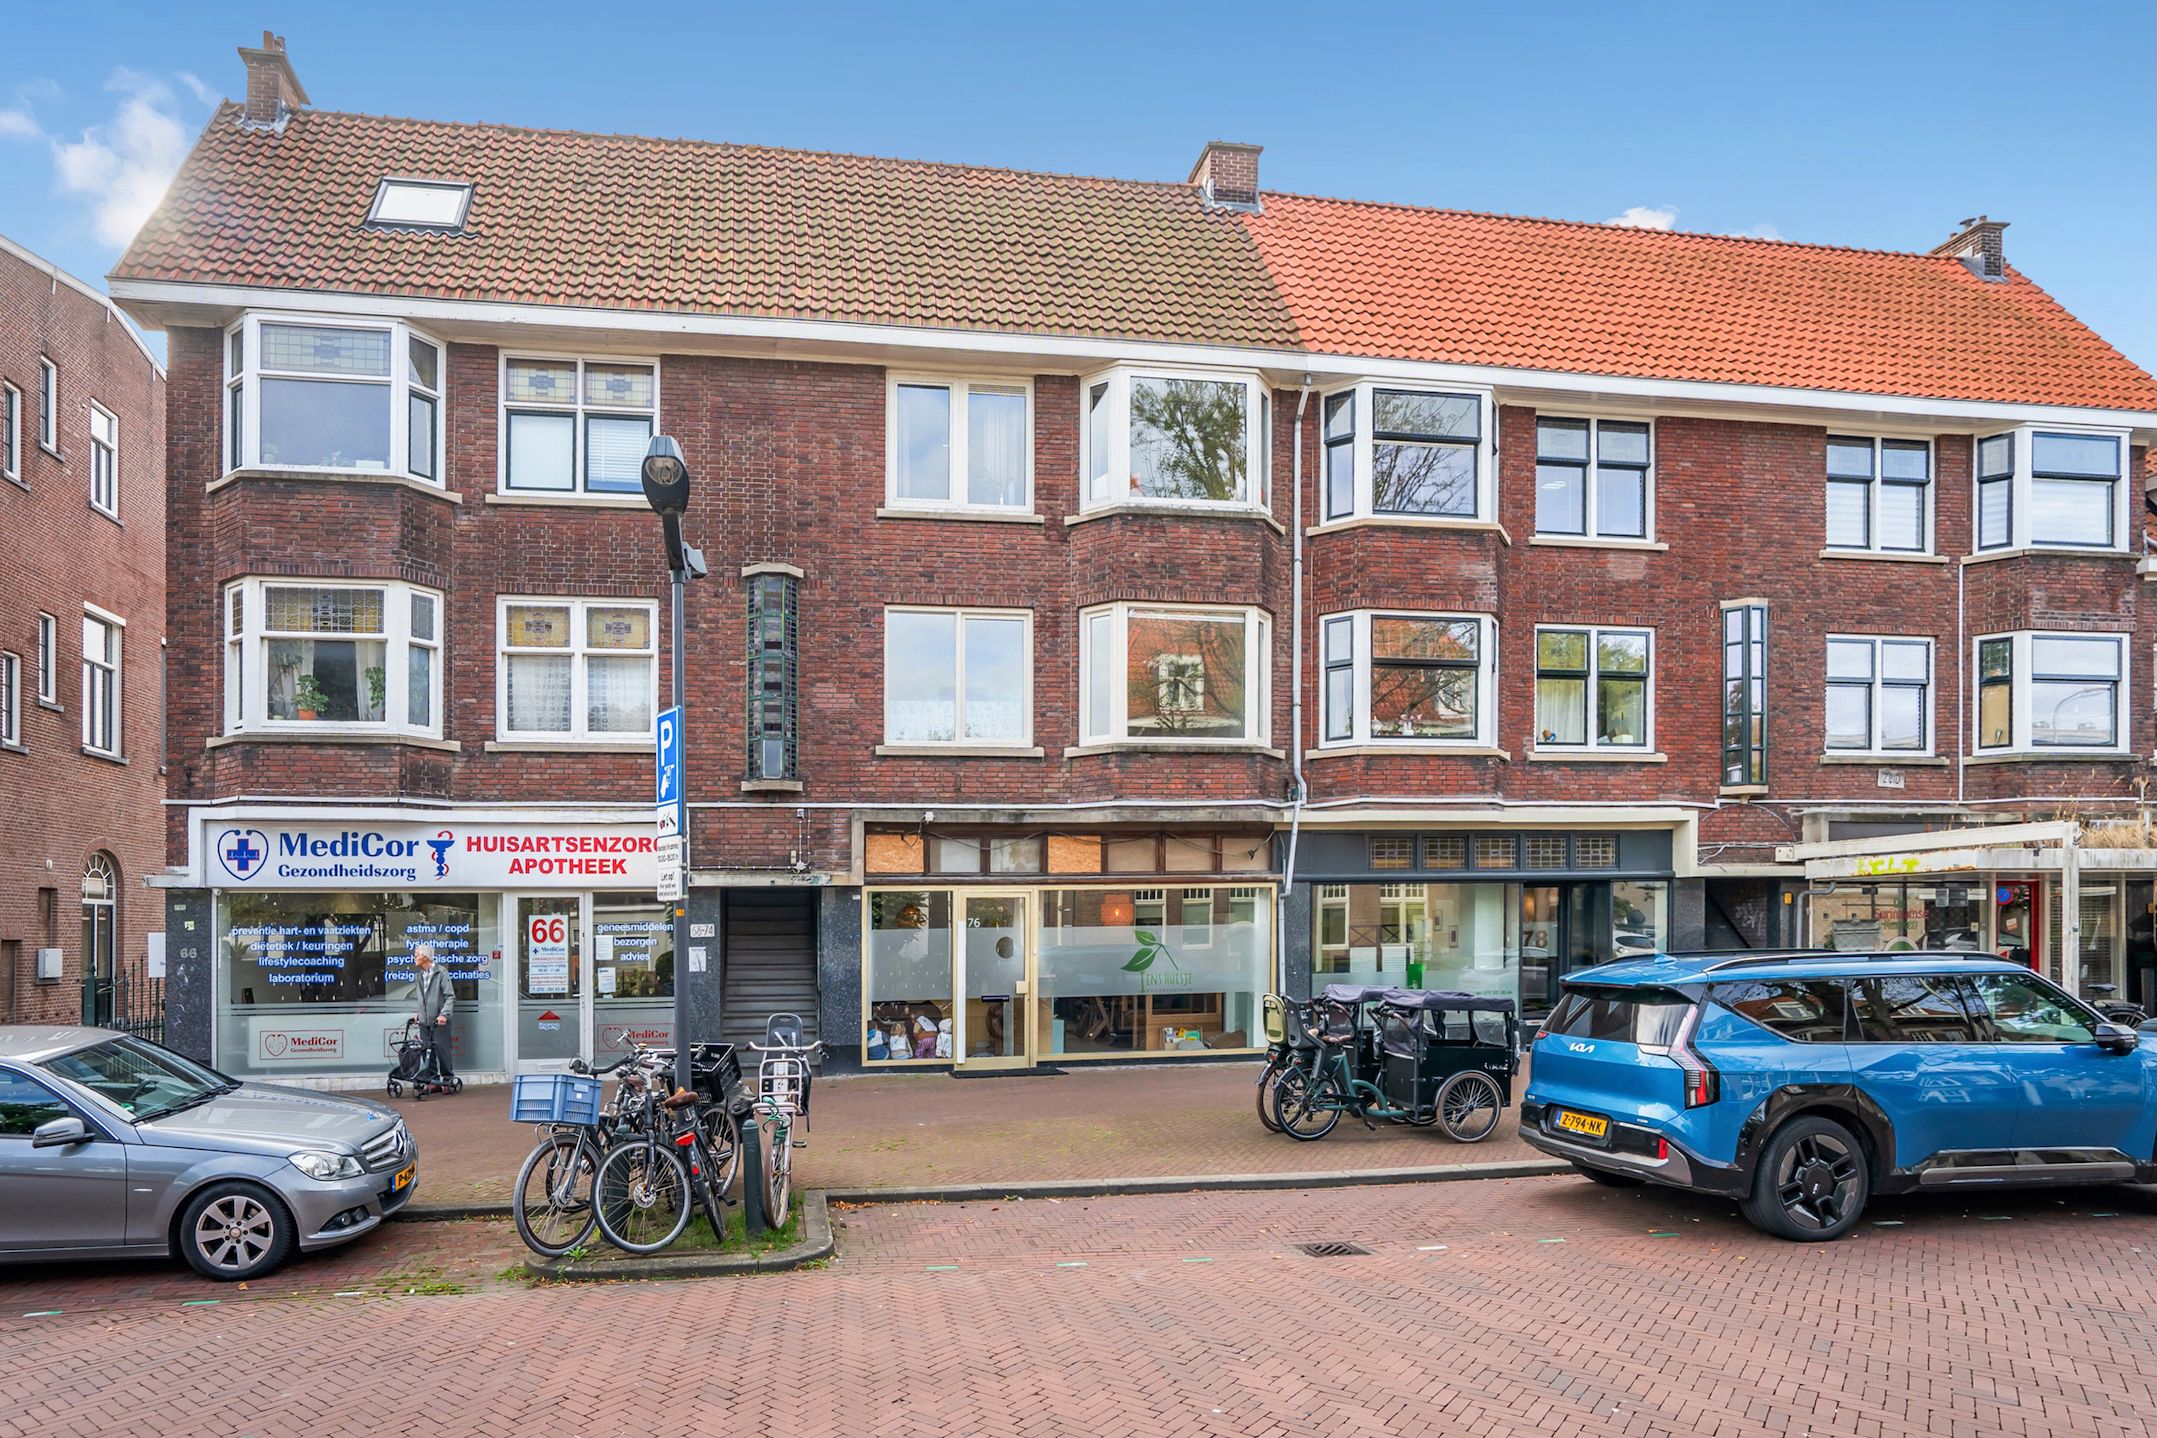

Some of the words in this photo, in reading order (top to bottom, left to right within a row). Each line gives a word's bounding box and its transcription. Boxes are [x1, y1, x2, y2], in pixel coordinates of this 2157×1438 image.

[661, 720, 673, 767] P
[280, 832, 419, 857] MediCor
[467, 836, 657, 853] HUISARTSENZOR
[508, 858, 628, 874] APOTHEEK
[278, 864, 417, 881] Gezondheidszorg
[597, 922, 674, 934] geneesmiddelen
[968, 917, 981, 928] 76
[232, 925, 277, 936] preventie
[279, 925, 302, 935] hart-
[303, 927, 316, 936] en
[318, 925, 371, 936] vaatziekten
[406, 924, 437, 933] astma
[444, 924, 470, 936] copd
[531, 918, 565, 944] 66
[614, 938, 657, 948] bezorgen
[1524, 930, 1549, 949] 78
[180, 948, 198, 959] 66
[250, 941, 294, 951] diëtetiek
[302, 941, 353, 954] keuringen
[387, 954, 464, 966] psychgische
[466, 956, 489, 966] zorg
[620, 951, 651, 961] advies
[258, 957, 345, 968] lifestylecoaching
[269, 973, 335, 983] laboratorium
[627, 1028, 670, 1039] MediCor
[290, 1036, 338, 1047] MediCor
[1562, 1114, 1603, 1133] Z-794-NK
